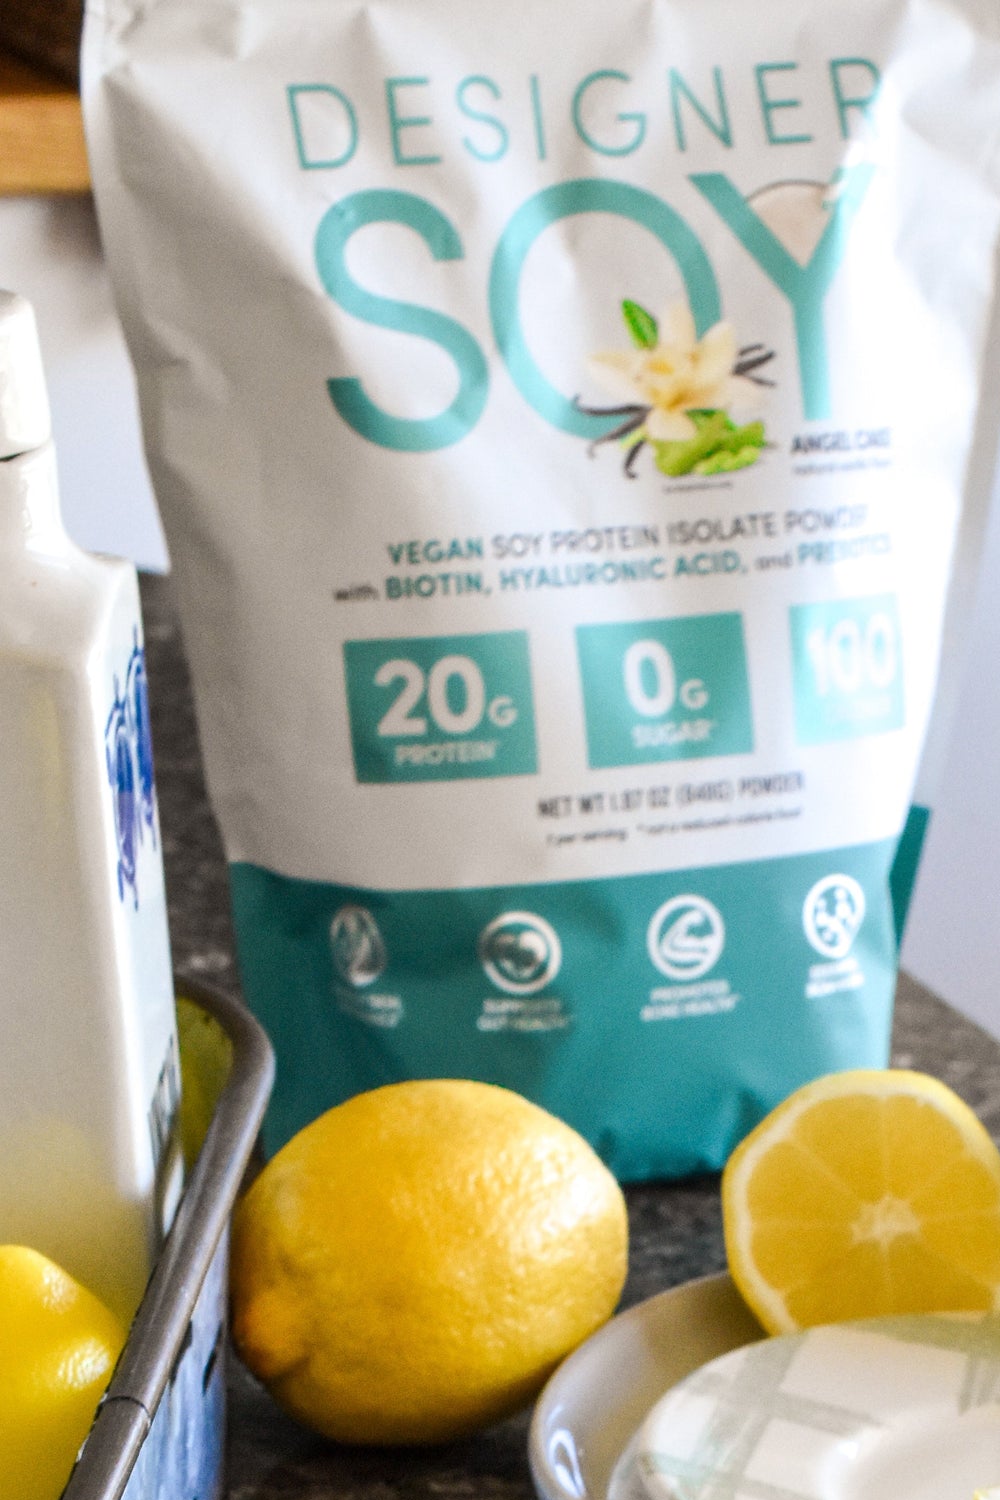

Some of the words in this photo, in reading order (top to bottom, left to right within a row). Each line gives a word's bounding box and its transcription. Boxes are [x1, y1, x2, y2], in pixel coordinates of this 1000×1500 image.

[286, 57, 882, 171] DESIGNER
[314, 163, 878, 453] SOY
[385, 571, 491, 600] BIOTIN,
[500, 555, 665, 591] HYALURONIC
[386, 536, 483, 565] VEGAN
[491, 533, 542, 559] SOY
[551, 524, 660, 556] PROTEIN
[666, 511, 776, 545] ISOLATE
